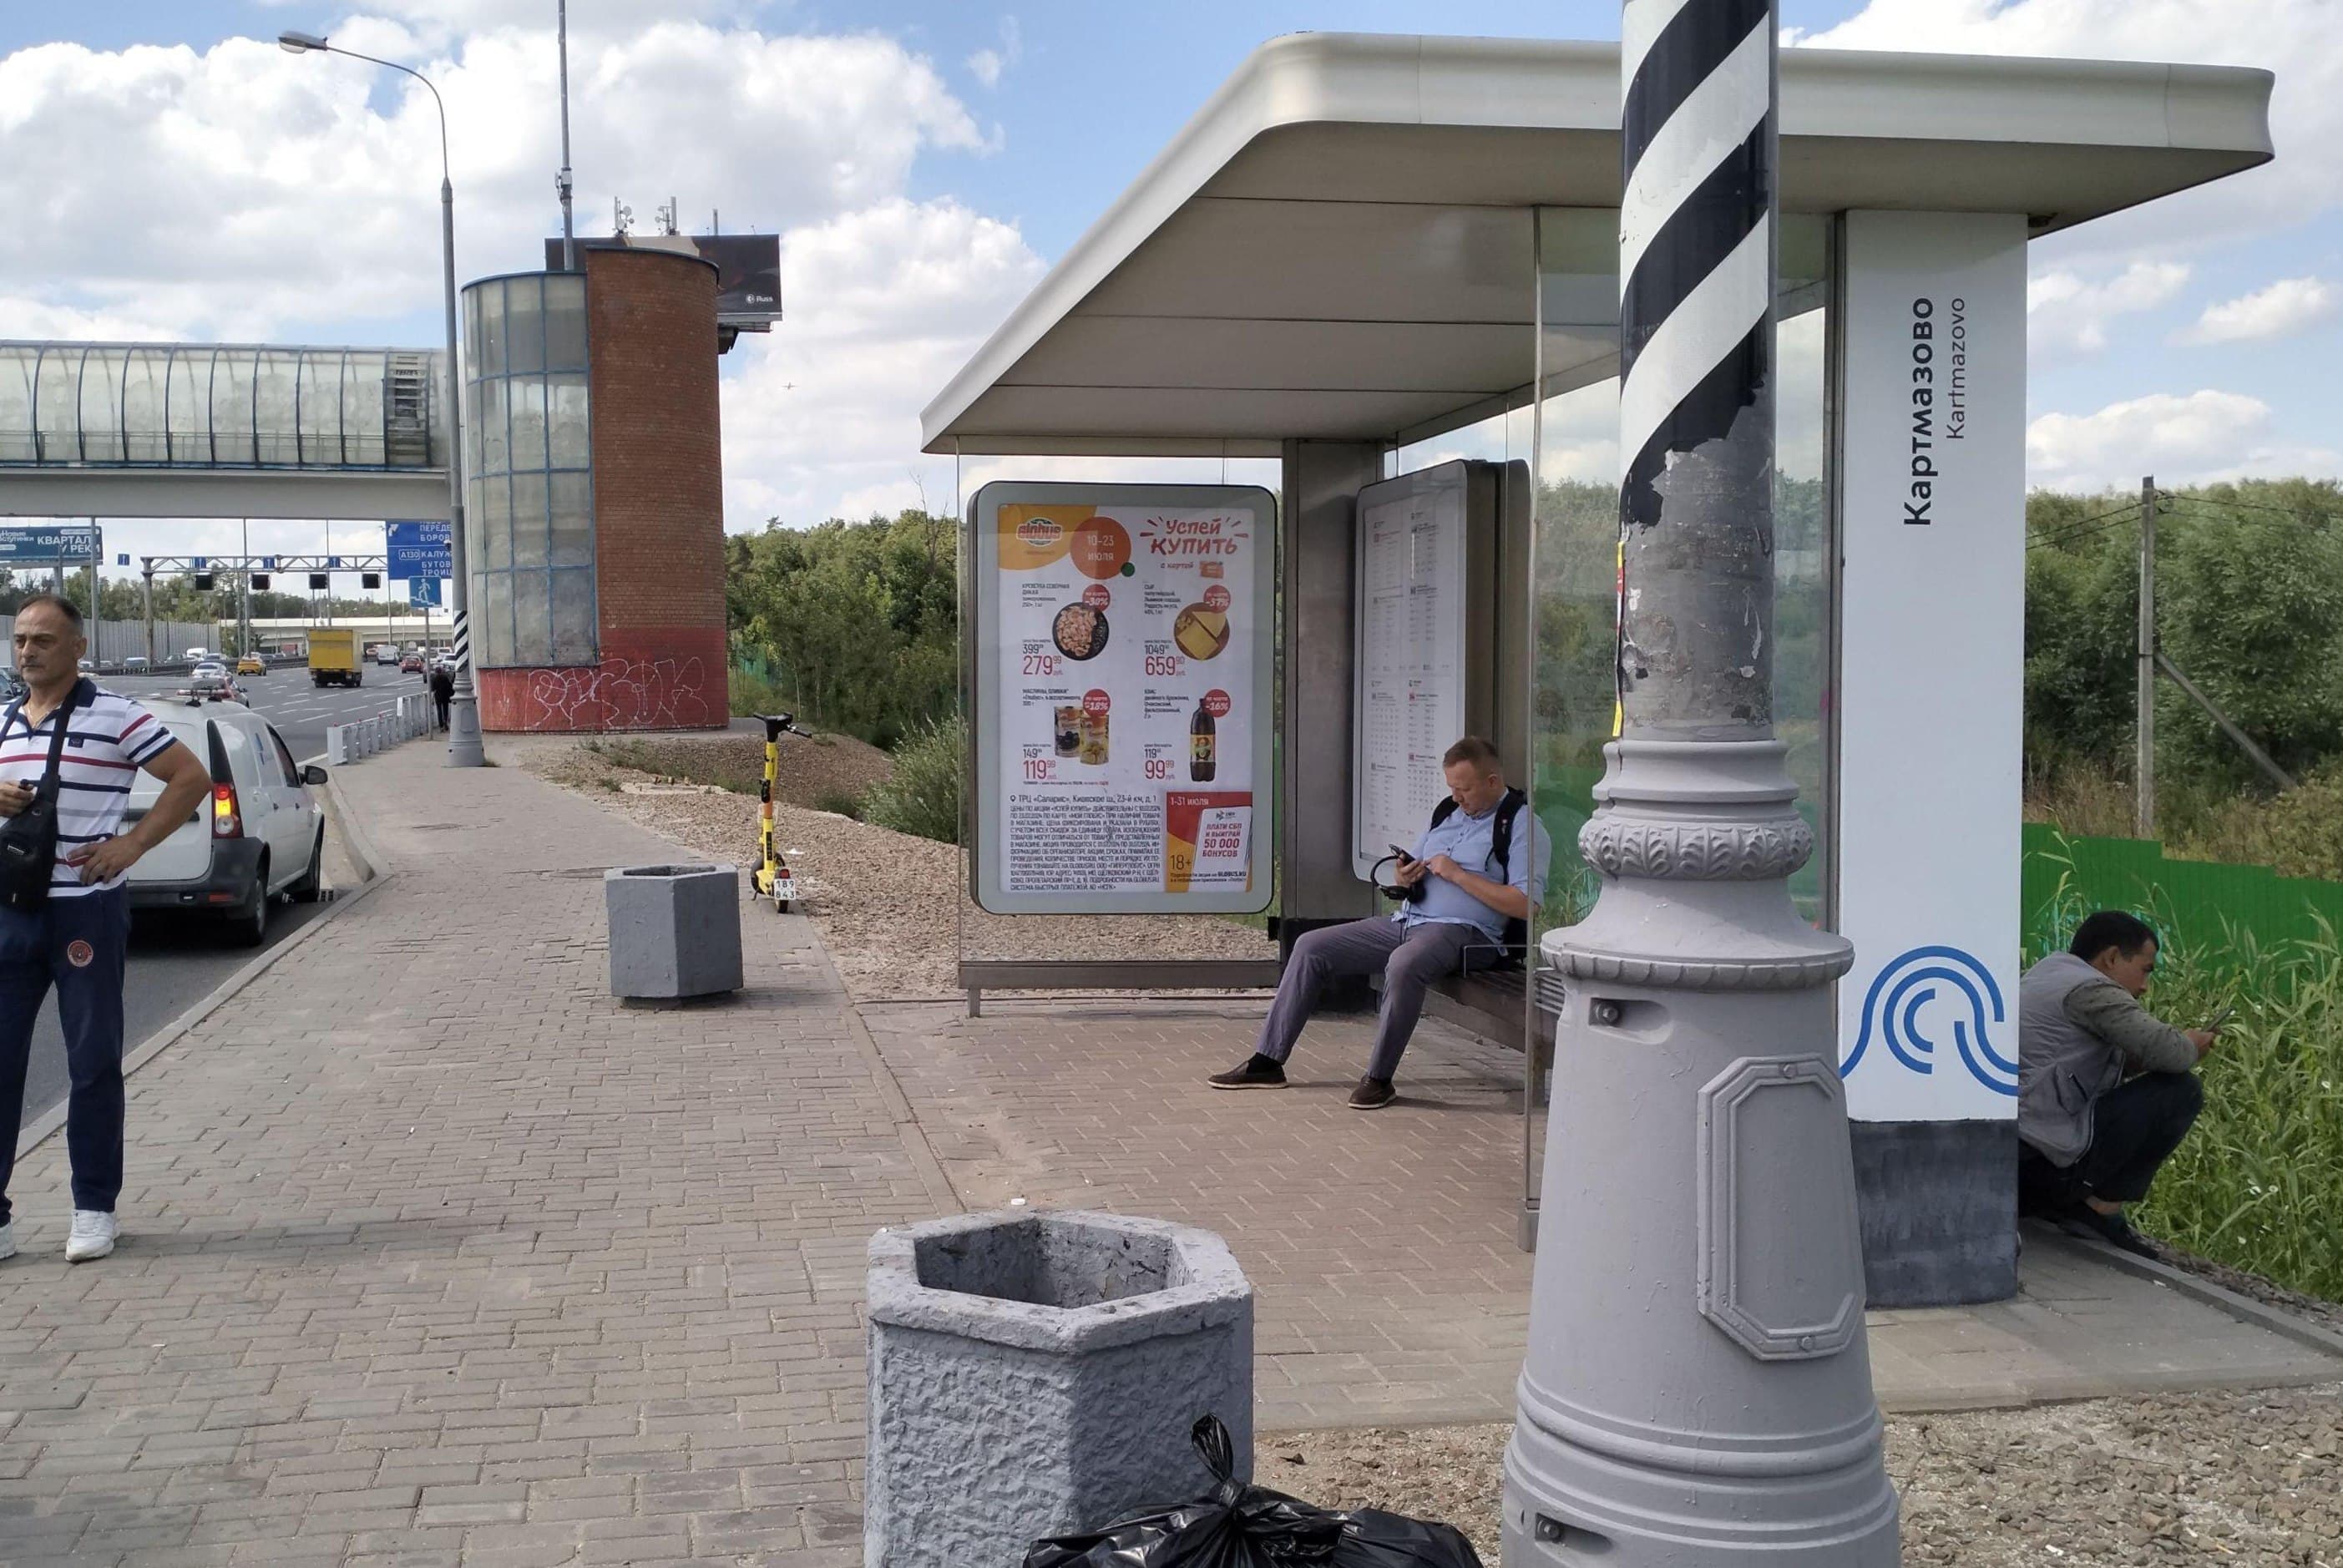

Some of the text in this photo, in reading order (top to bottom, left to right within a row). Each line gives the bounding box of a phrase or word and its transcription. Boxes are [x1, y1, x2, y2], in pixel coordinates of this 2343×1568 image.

[1946, 297, 1966, 439] Kartmazovo
[1904, 297, 1938, 525] Картмазово
[37, 535, 91, 544] КВАРТАЛ
[420, 534, 450, 542] БОРОВ
[1151, 538, 1237, 555] КУПИТЬ
[421, 550, 450, 559] КАЛУЖ
[1023, 644, 1040, 655] 399
[1145, 644, 1165, 655] 1049
[1023, 655, 1053, 675] 279
[1146, 655, 1176, 676] 659
[1023, 748, 1038, 758] 149
[1145, 748, 1156, 758] 119
[1023, 760, 1047, 780] 119
[1145, 760, 1165, 780] 99
[1204, 837, 1240, 848] 50 000
[1170, 854, 1192, 870] 18+
[776, 880, 794, 888] 189
